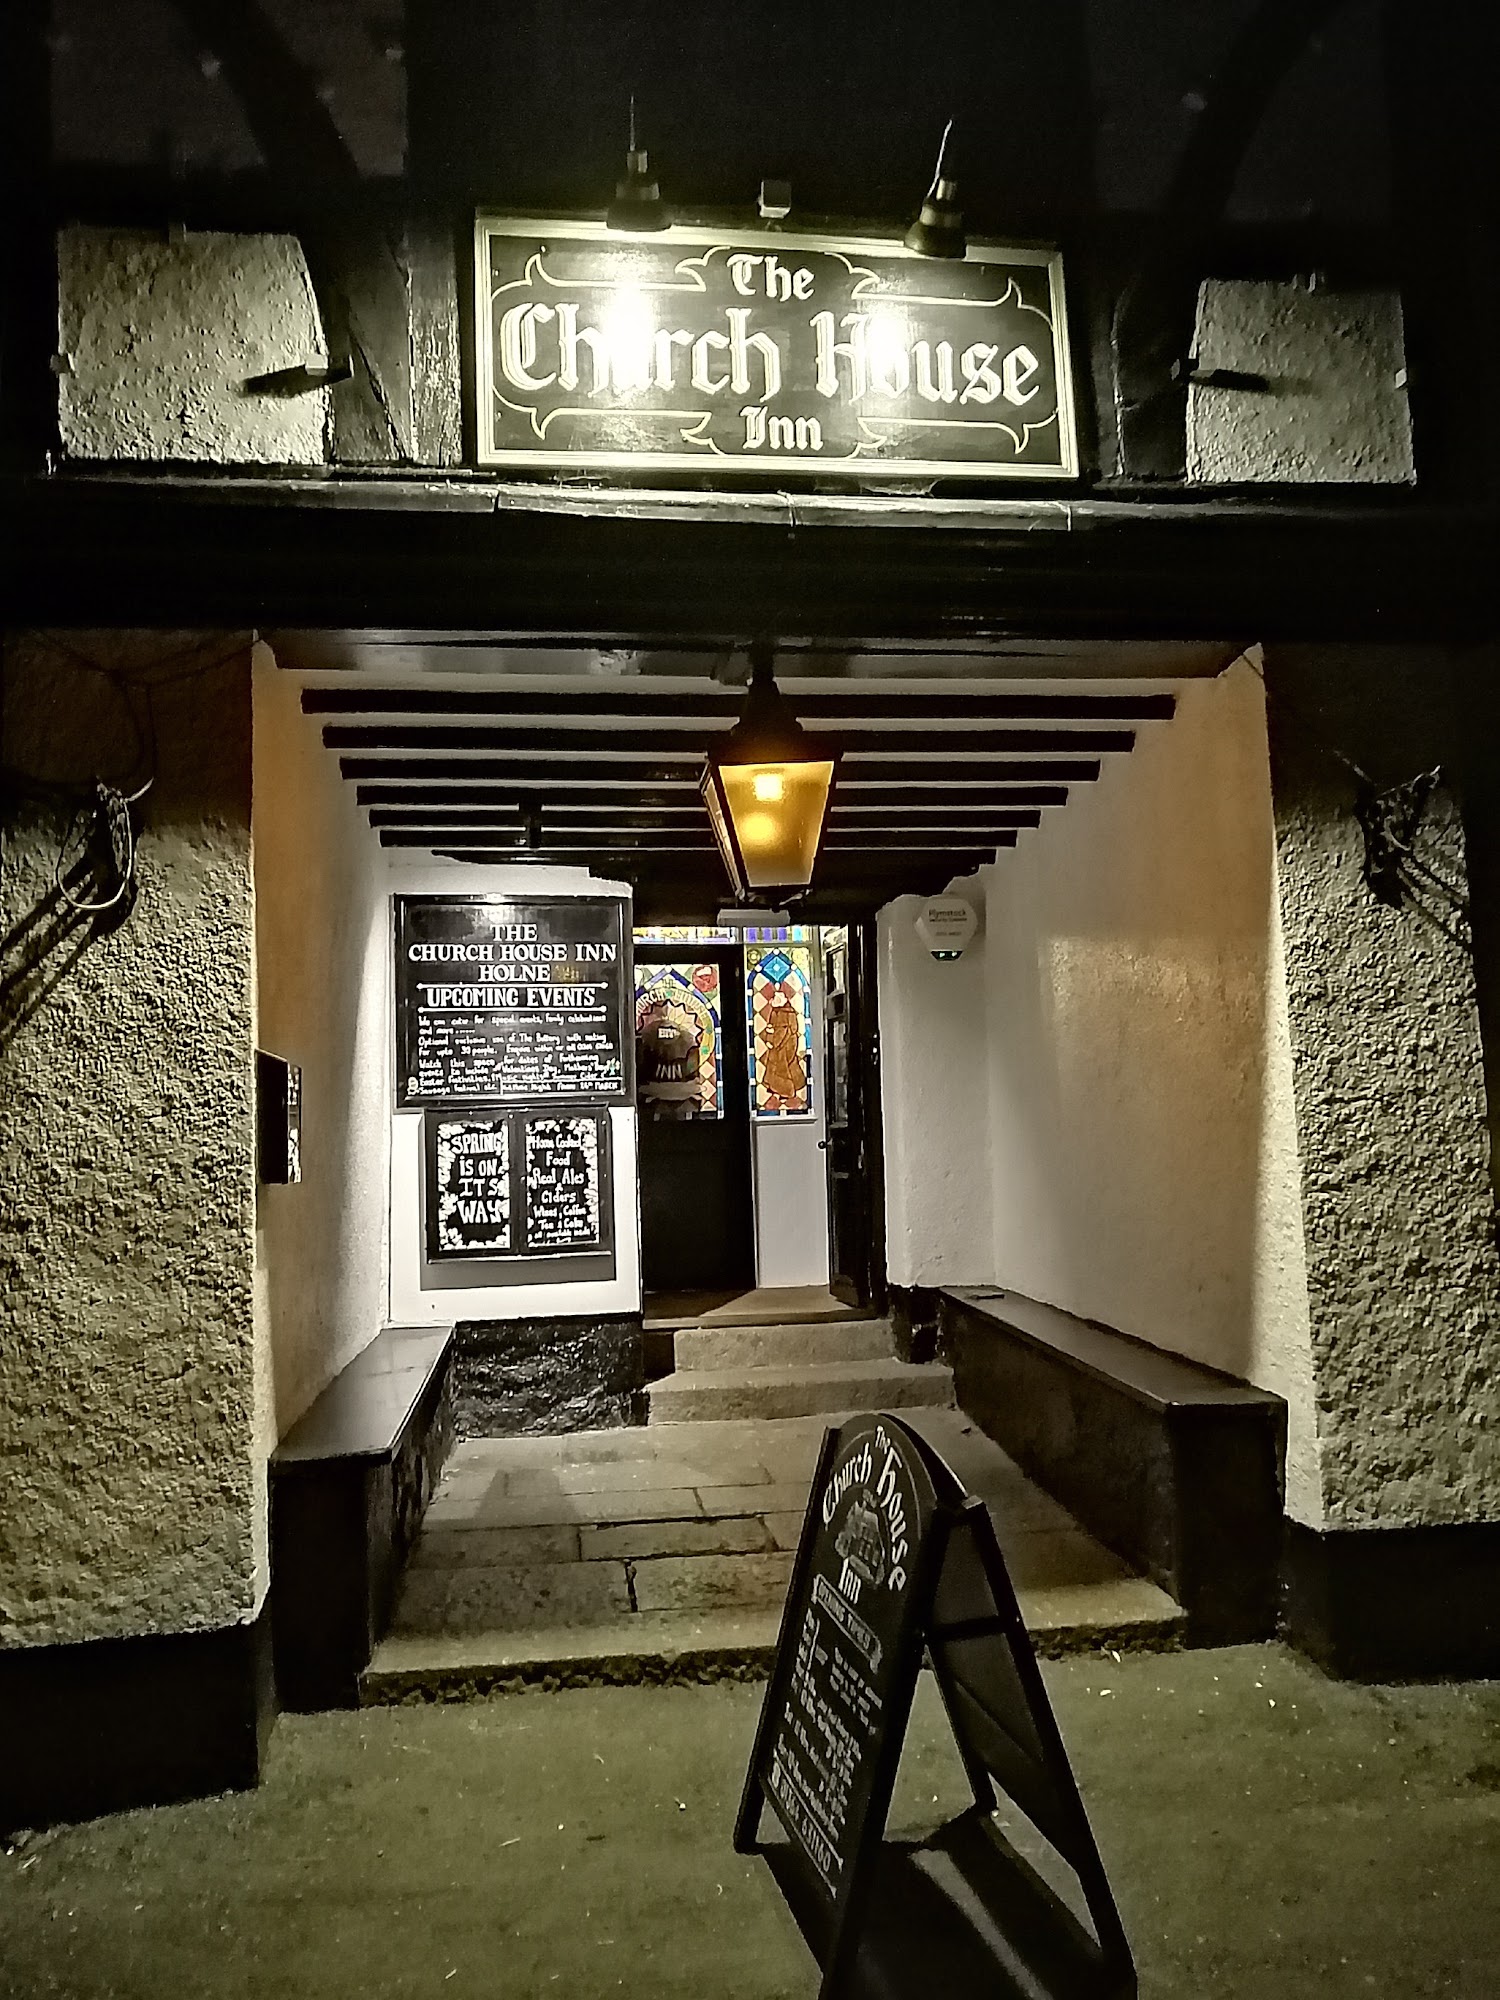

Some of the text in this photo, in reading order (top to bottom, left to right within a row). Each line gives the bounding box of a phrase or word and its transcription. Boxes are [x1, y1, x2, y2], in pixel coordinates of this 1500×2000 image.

[726, 254, 815, 302] The
[740, 406, 823, 451] Inn
[490, 924, 538, 942] THE
[408, 943, 617, 962] CHURCH HOUSE INN
[478, 964, 550, 982] HOLNE
[427, 987, 596, 1007] UPCOMING EVENTS
[656, 1064, 682, 1080] INN
[478, 1159, 498, 1176] ON
[546, 1151, 571, 1167] Food
[533, 1167, 584, 1185] Real Ales
[456, 1200, 501, 1224] WAY
[875, 1425, 891, 1454] The
[823, 1442, 872, 1531] Church
[838, 1556, 862, 1605] Inn
